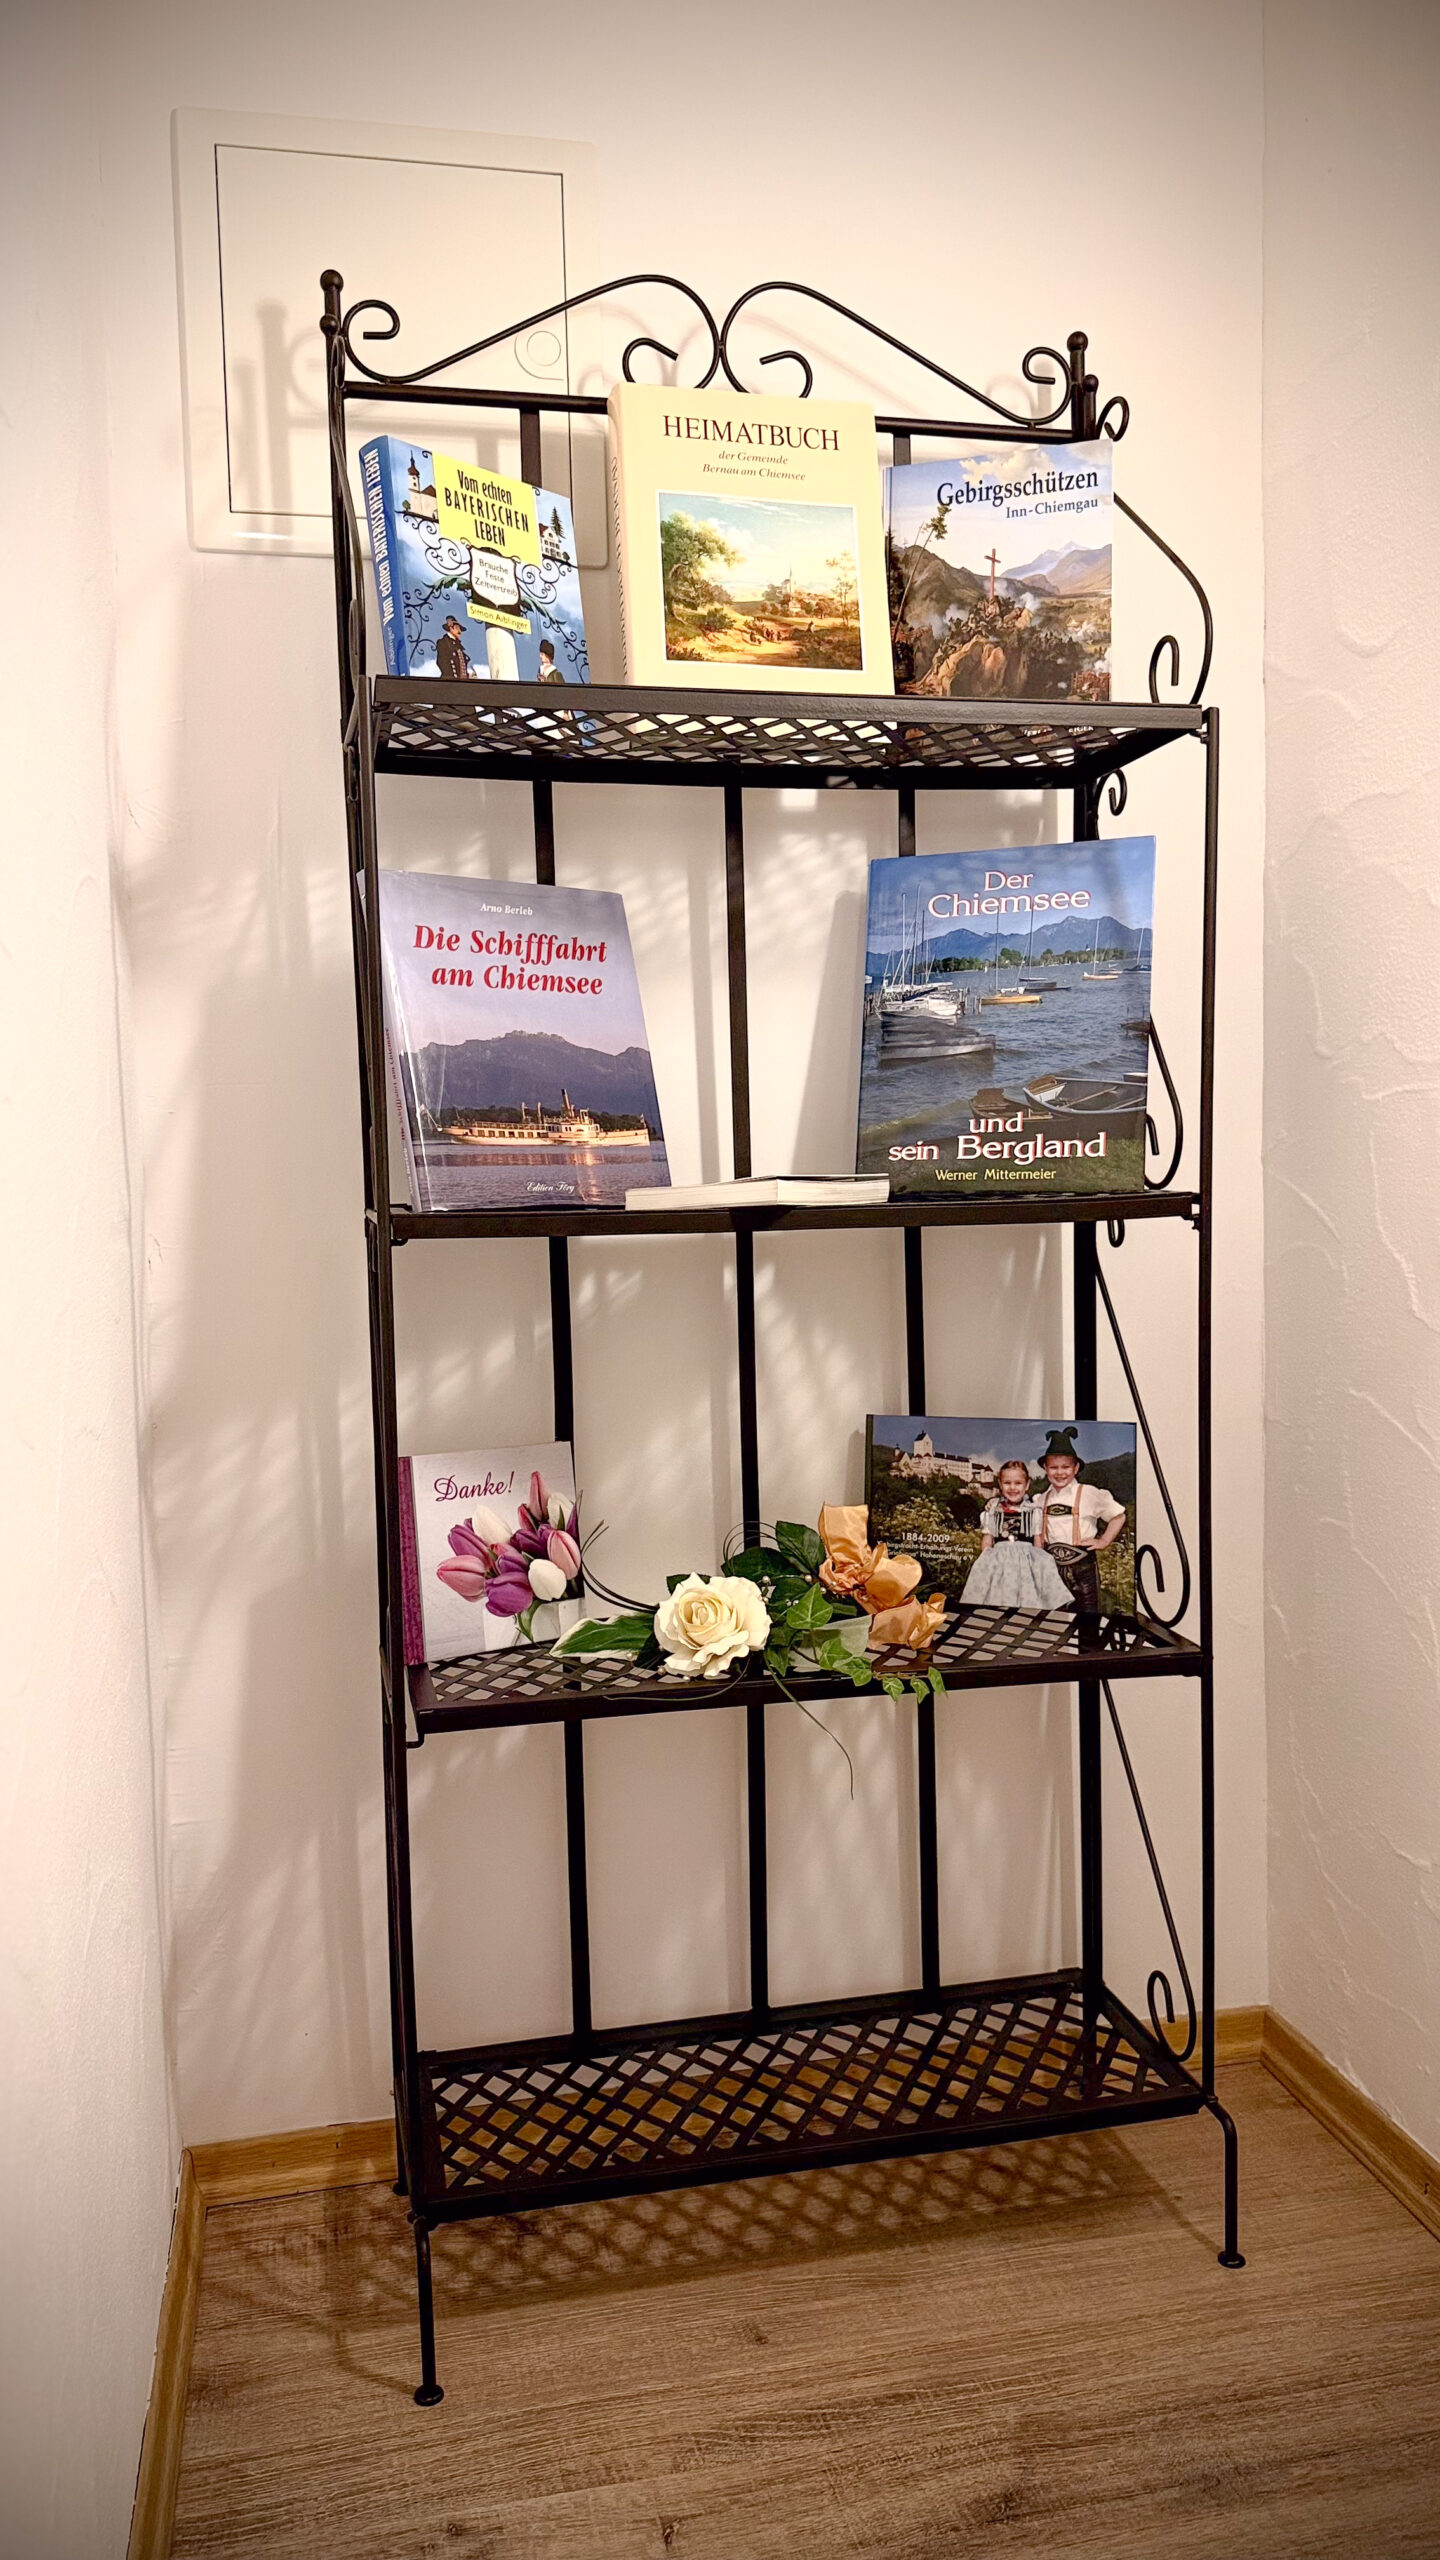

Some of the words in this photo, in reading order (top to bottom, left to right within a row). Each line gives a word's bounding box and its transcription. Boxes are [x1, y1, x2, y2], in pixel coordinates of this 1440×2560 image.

[662, 415, 840, 451] HEIMATBUCH
[364, 448, 380, 488] LEBEN
[718, 450, 735, 461] der
[737, 451, 789, 465] Gemeinde
[702, 463, 739, 476] Bernau
[740, 469, 757, 477] am
[758, 467, 806, 481] Chiemsee
[457, 469, 479, 494] Vom
[482, 481, 512, 506] echten
[937, 470, 1099, 507] Gebirgsschützen
[444, 486, 529, 533] BAYERISCHEN
[1006, 498, 1099, 519] Inn-Chiemgau
[368, 485, 389, 563] BAYERISCHEN
[474, 519, 505, 546] LEBEN
[475, 576, 518, 597] Zeitvertreib
[485, 570, 505, 584] Feste
[383, 597, 395, 626] Vom
[470, 605, 495, 620] Simon
[984, 870, 1034, 892] Der
[480, 903, 503, 913] Arno
[928, 889, 1091, 919] Chiemsee
[413, 924, 461, 951] Die
[470, 930, 608, 966] Schifffahrt
[431, 966, 475, 988] am
[484, 965, 603, 995] Chiemsee
[969, 1111, 1024, 1133] und
[888, 1141, 940, 1161] sein
[956, 1132, 1107, 1166] Bergland
[526, 1180, 554, 1192] Edition
[935, 1169, 978, 1181] Werner
[984, 1168, 1057, 1180] Mittermeier
[434, 1471, 515, 1501] Danke!
[901, 1532, 951, 1543] 1884-2009
